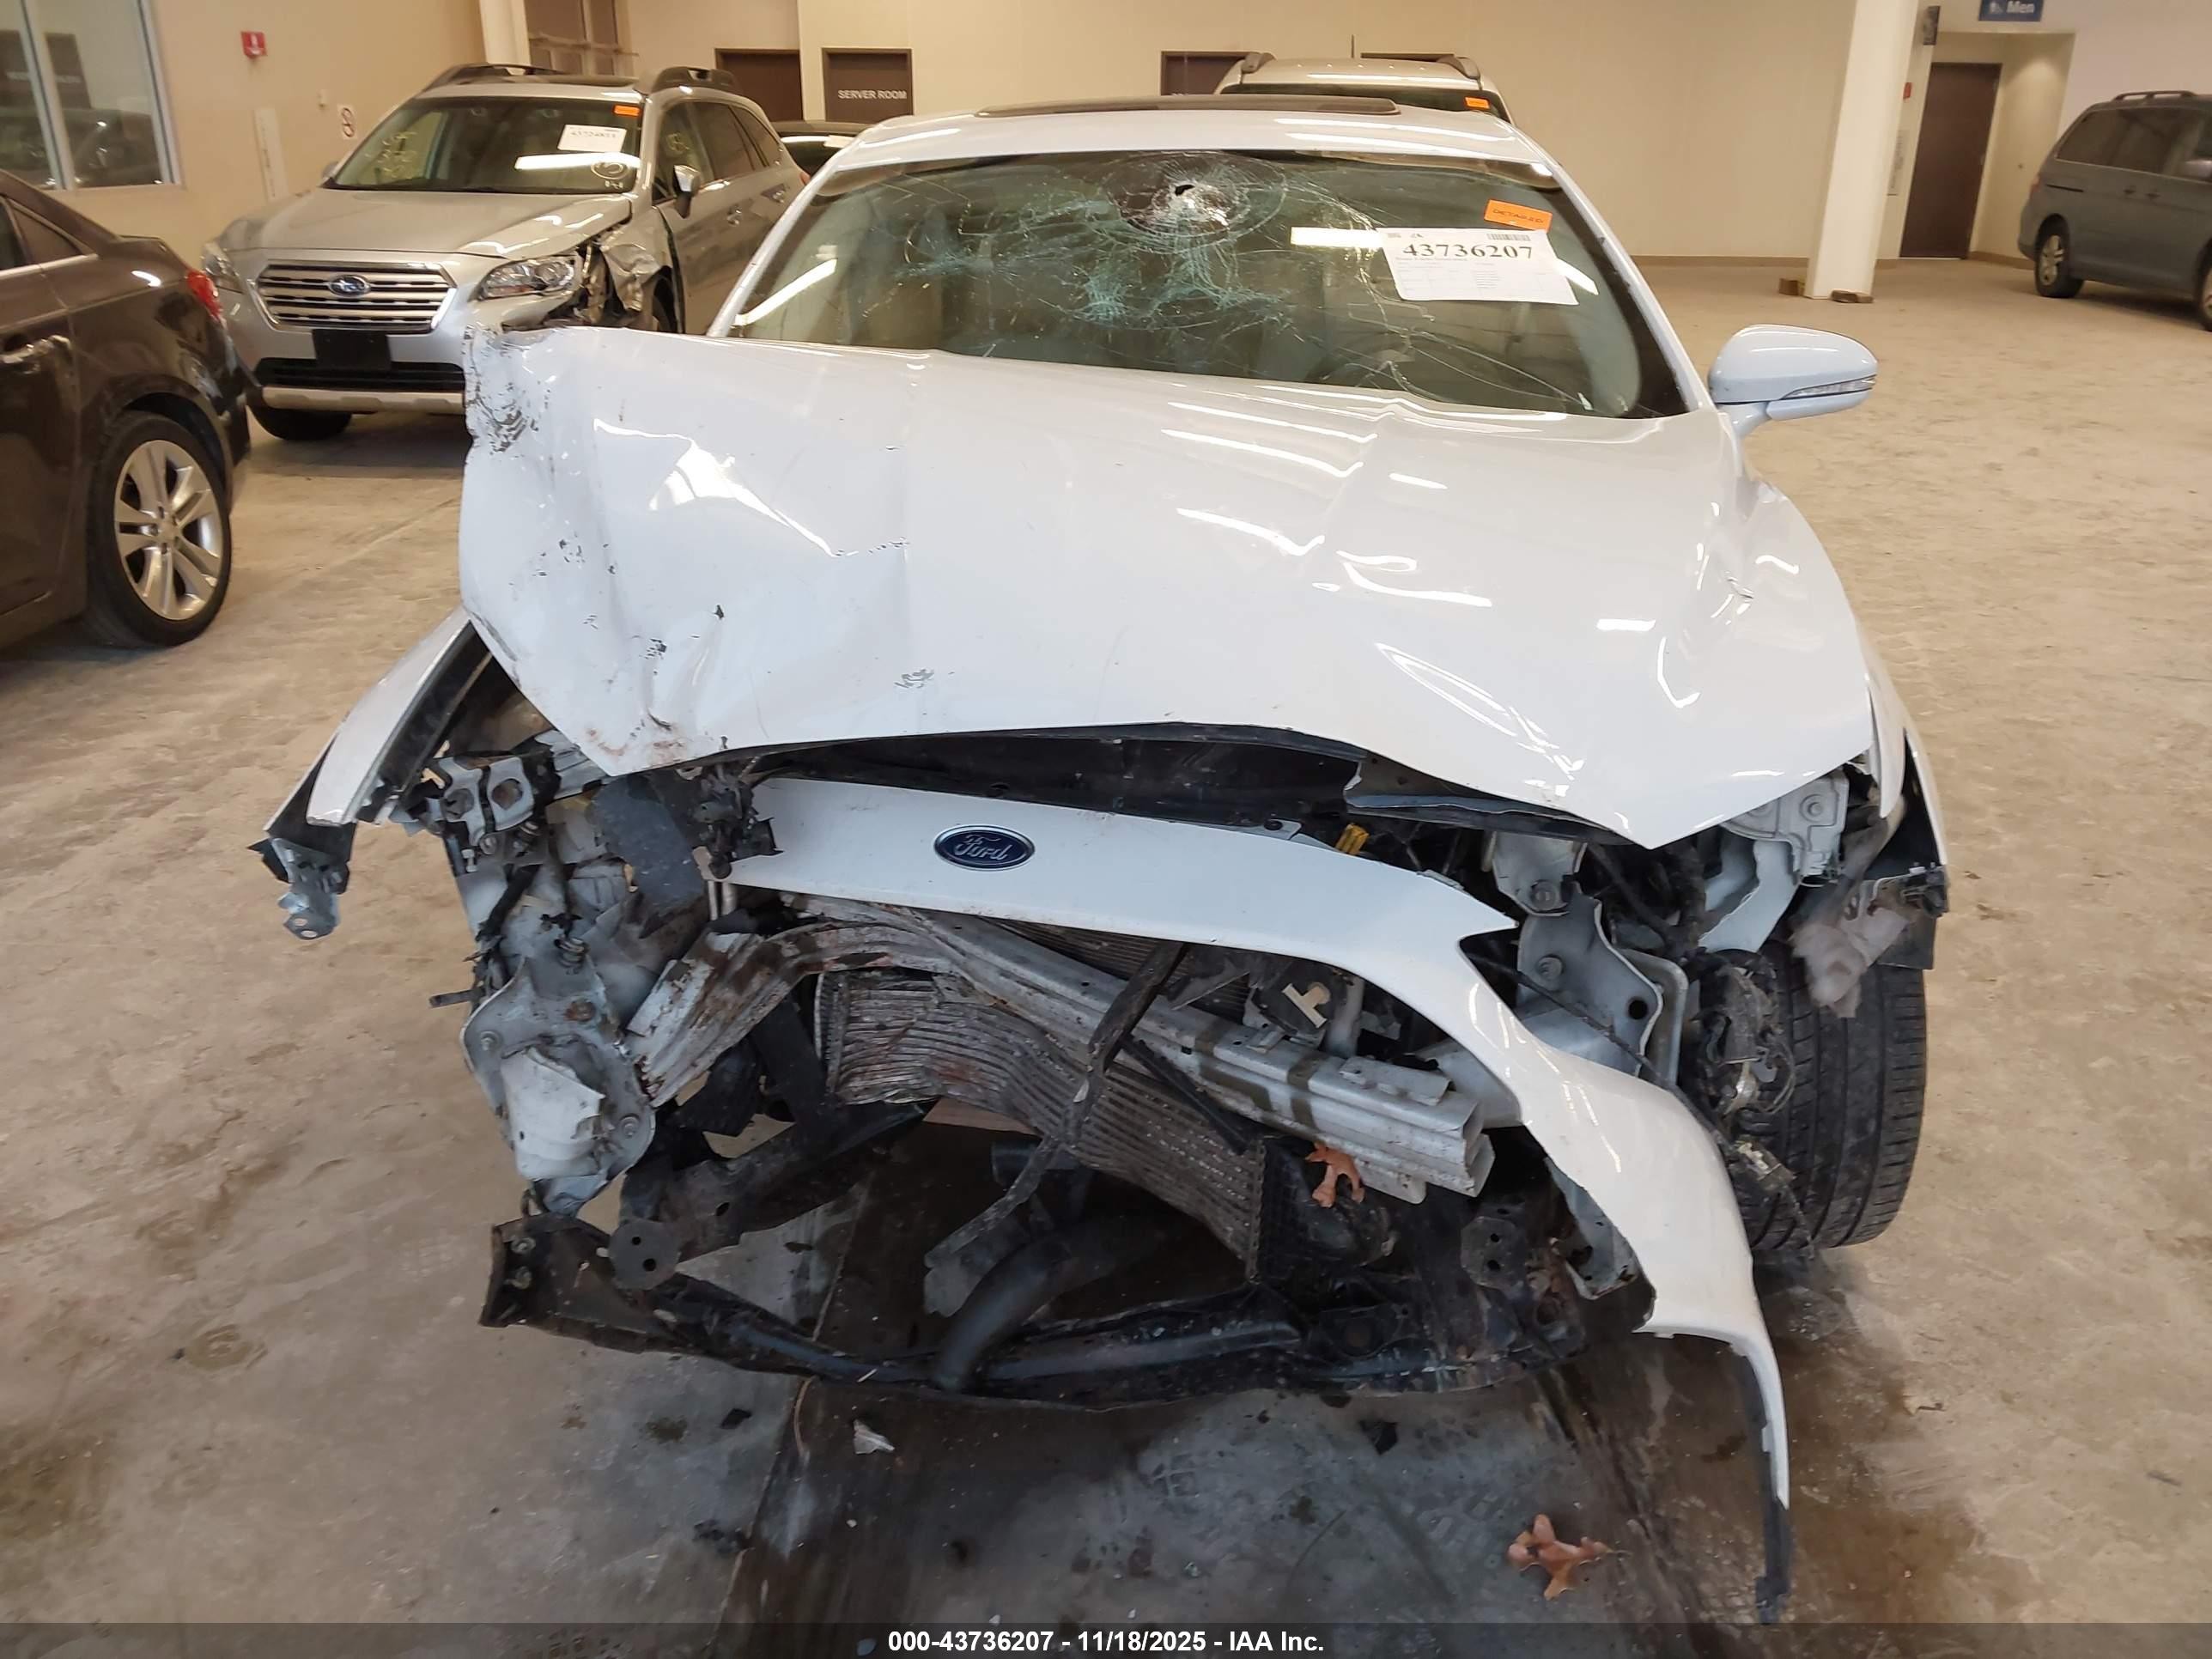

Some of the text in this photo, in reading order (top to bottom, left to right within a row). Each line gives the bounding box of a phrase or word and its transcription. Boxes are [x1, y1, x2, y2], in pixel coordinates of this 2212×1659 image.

[2006, 1, 2035, 13] Men
[837, 89, 908, 100] SERVER ROOM
[1402, 244, 1533, 258] 43736207
[954, 834, 1013, 860] Ford
